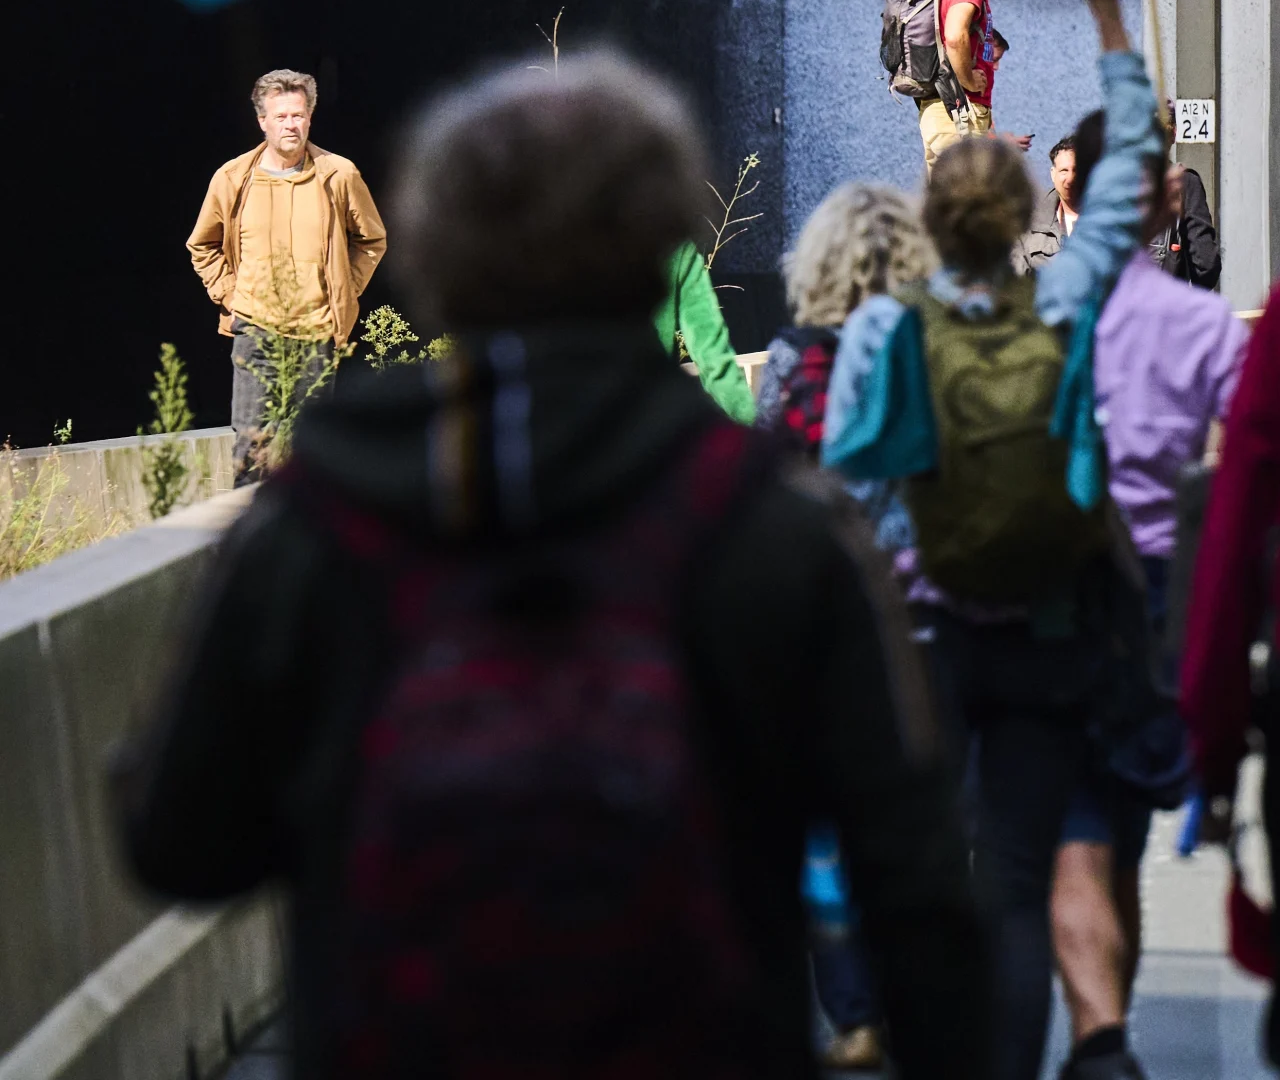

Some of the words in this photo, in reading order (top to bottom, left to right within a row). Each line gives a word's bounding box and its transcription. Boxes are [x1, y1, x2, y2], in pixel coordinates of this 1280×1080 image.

[1182, 103, 1199, 115] A12
[1202, 103, 1209, 115] N
[1182, 119, 1209, 140] 2,4
